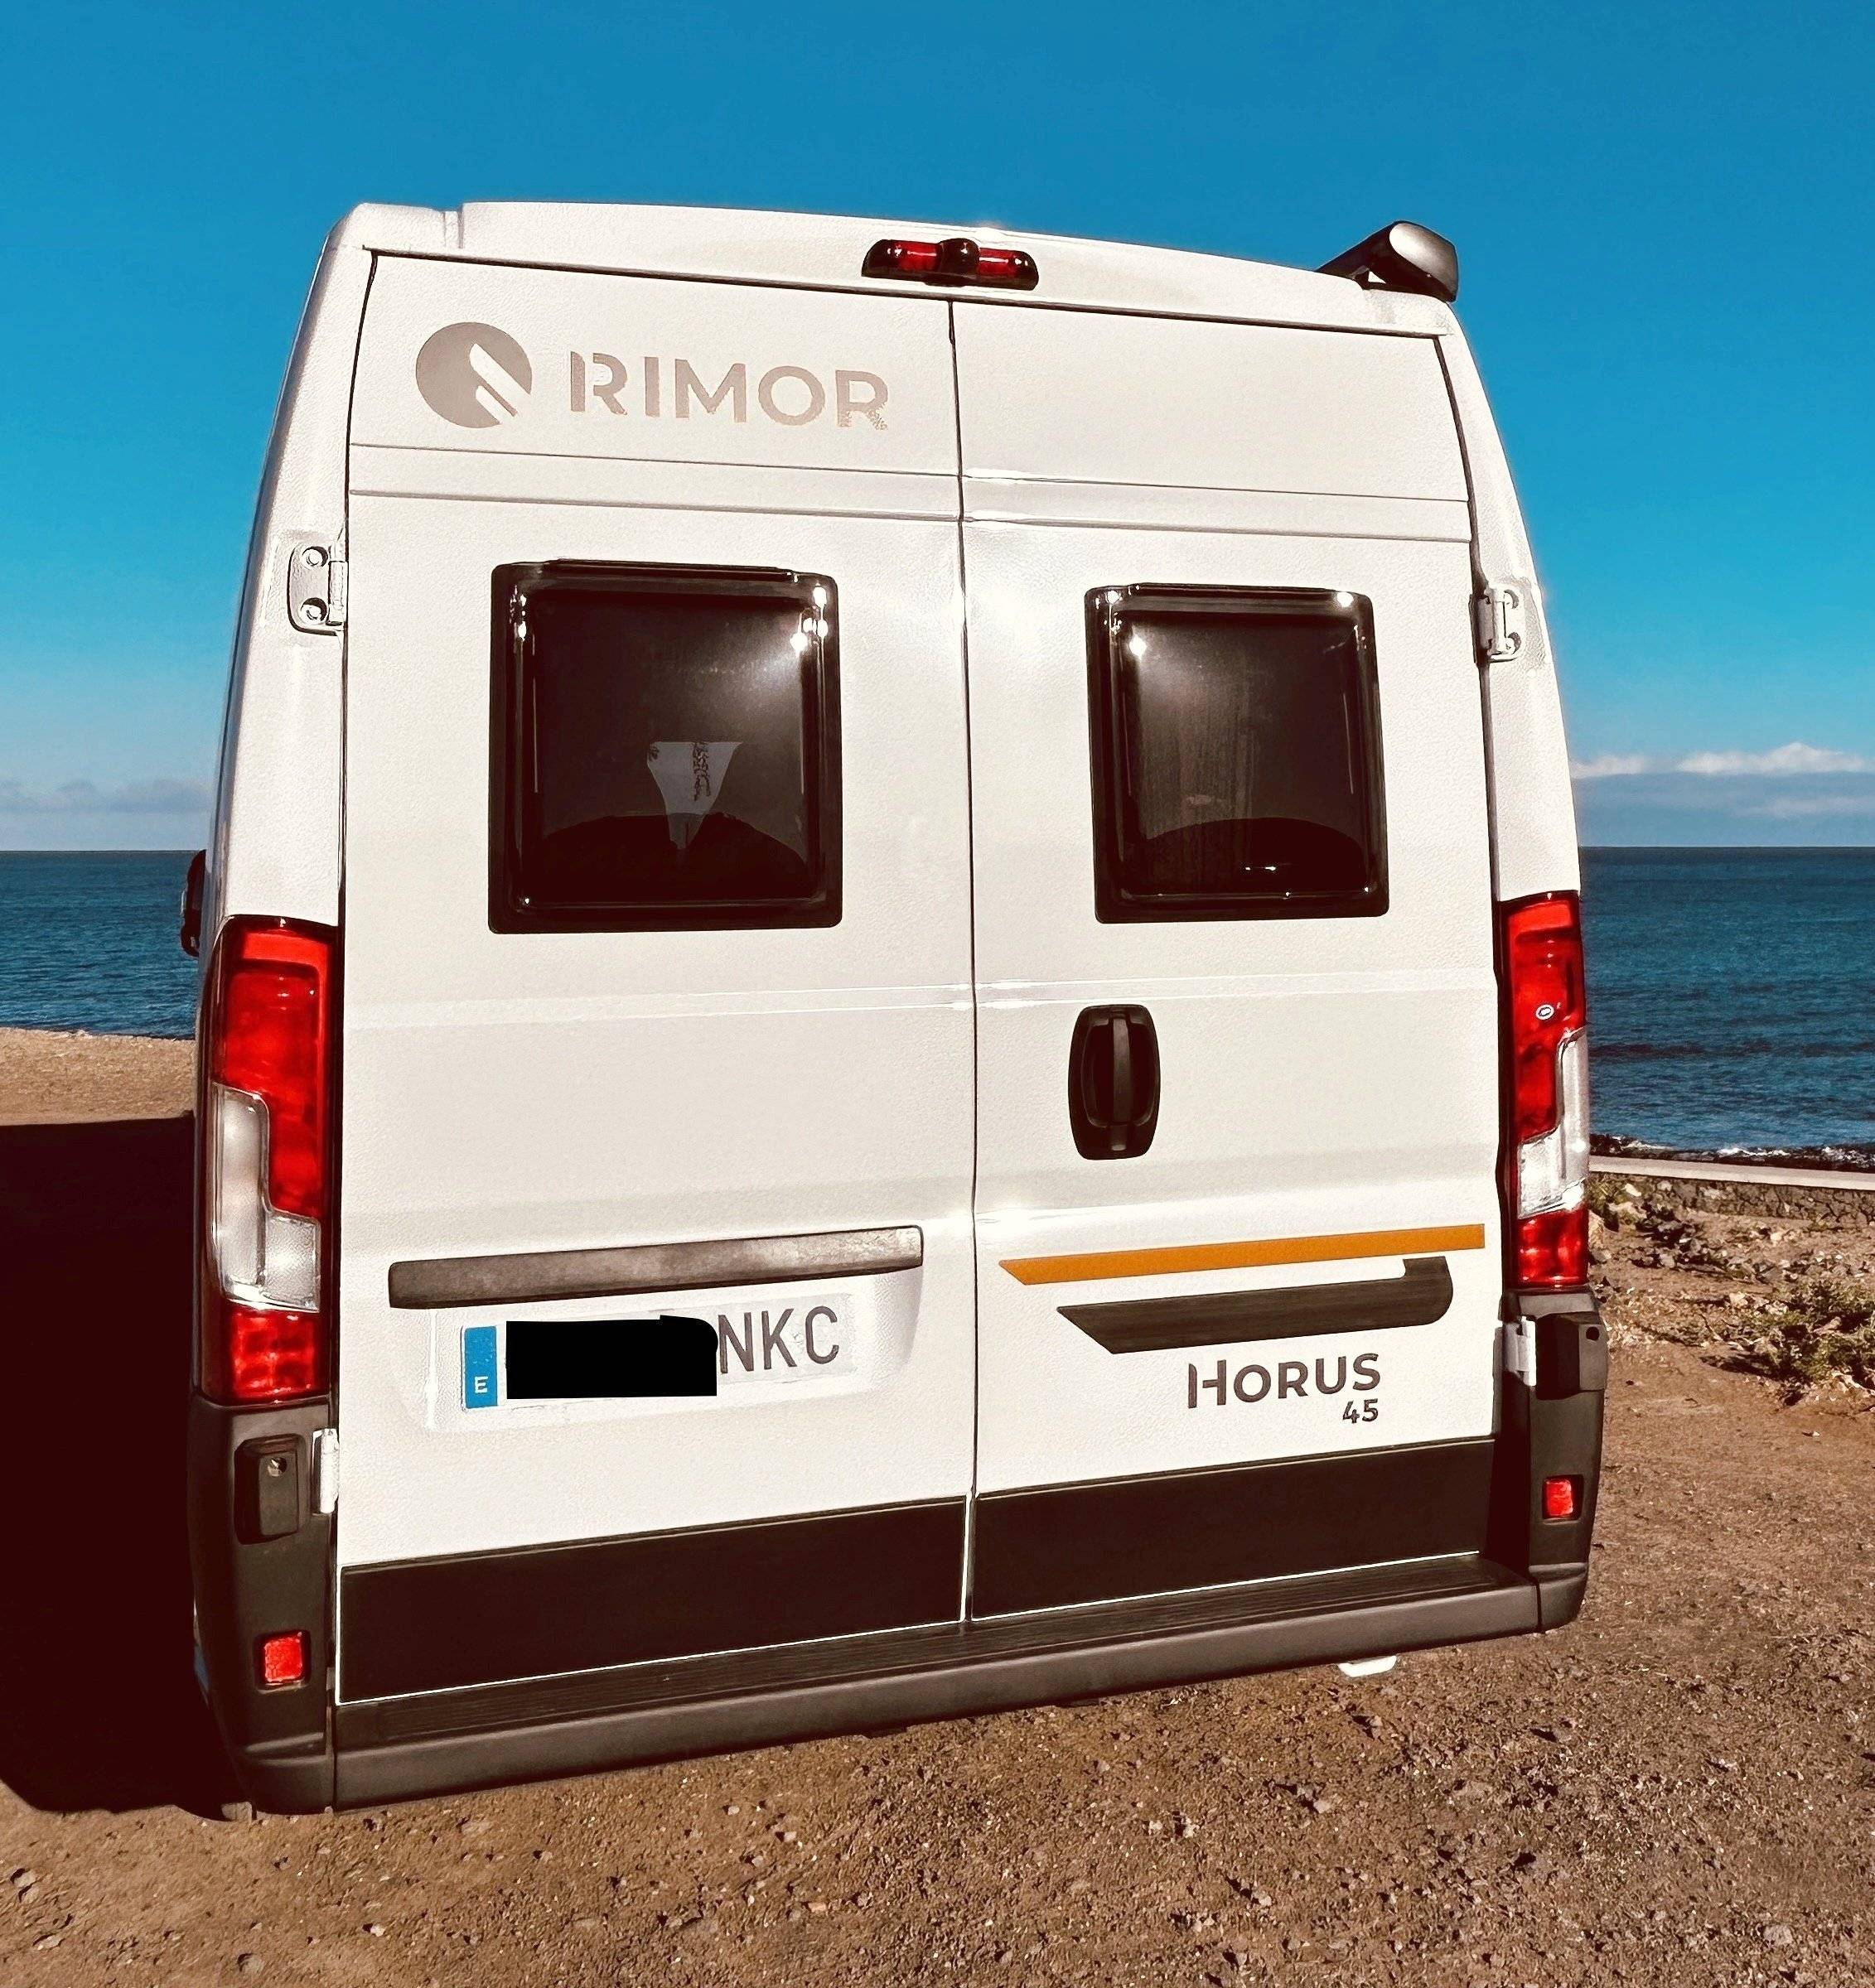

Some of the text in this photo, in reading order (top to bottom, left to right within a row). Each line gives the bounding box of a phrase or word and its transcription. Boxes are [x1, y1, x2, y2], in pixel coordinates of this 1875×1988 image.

[570, 351, 889, 430] RIMOR
[474, 1376, 487, 1392] E
[1188, 1353, 1380, 1408] HORUS
[1342, 1398, 1379, 1423] 45
